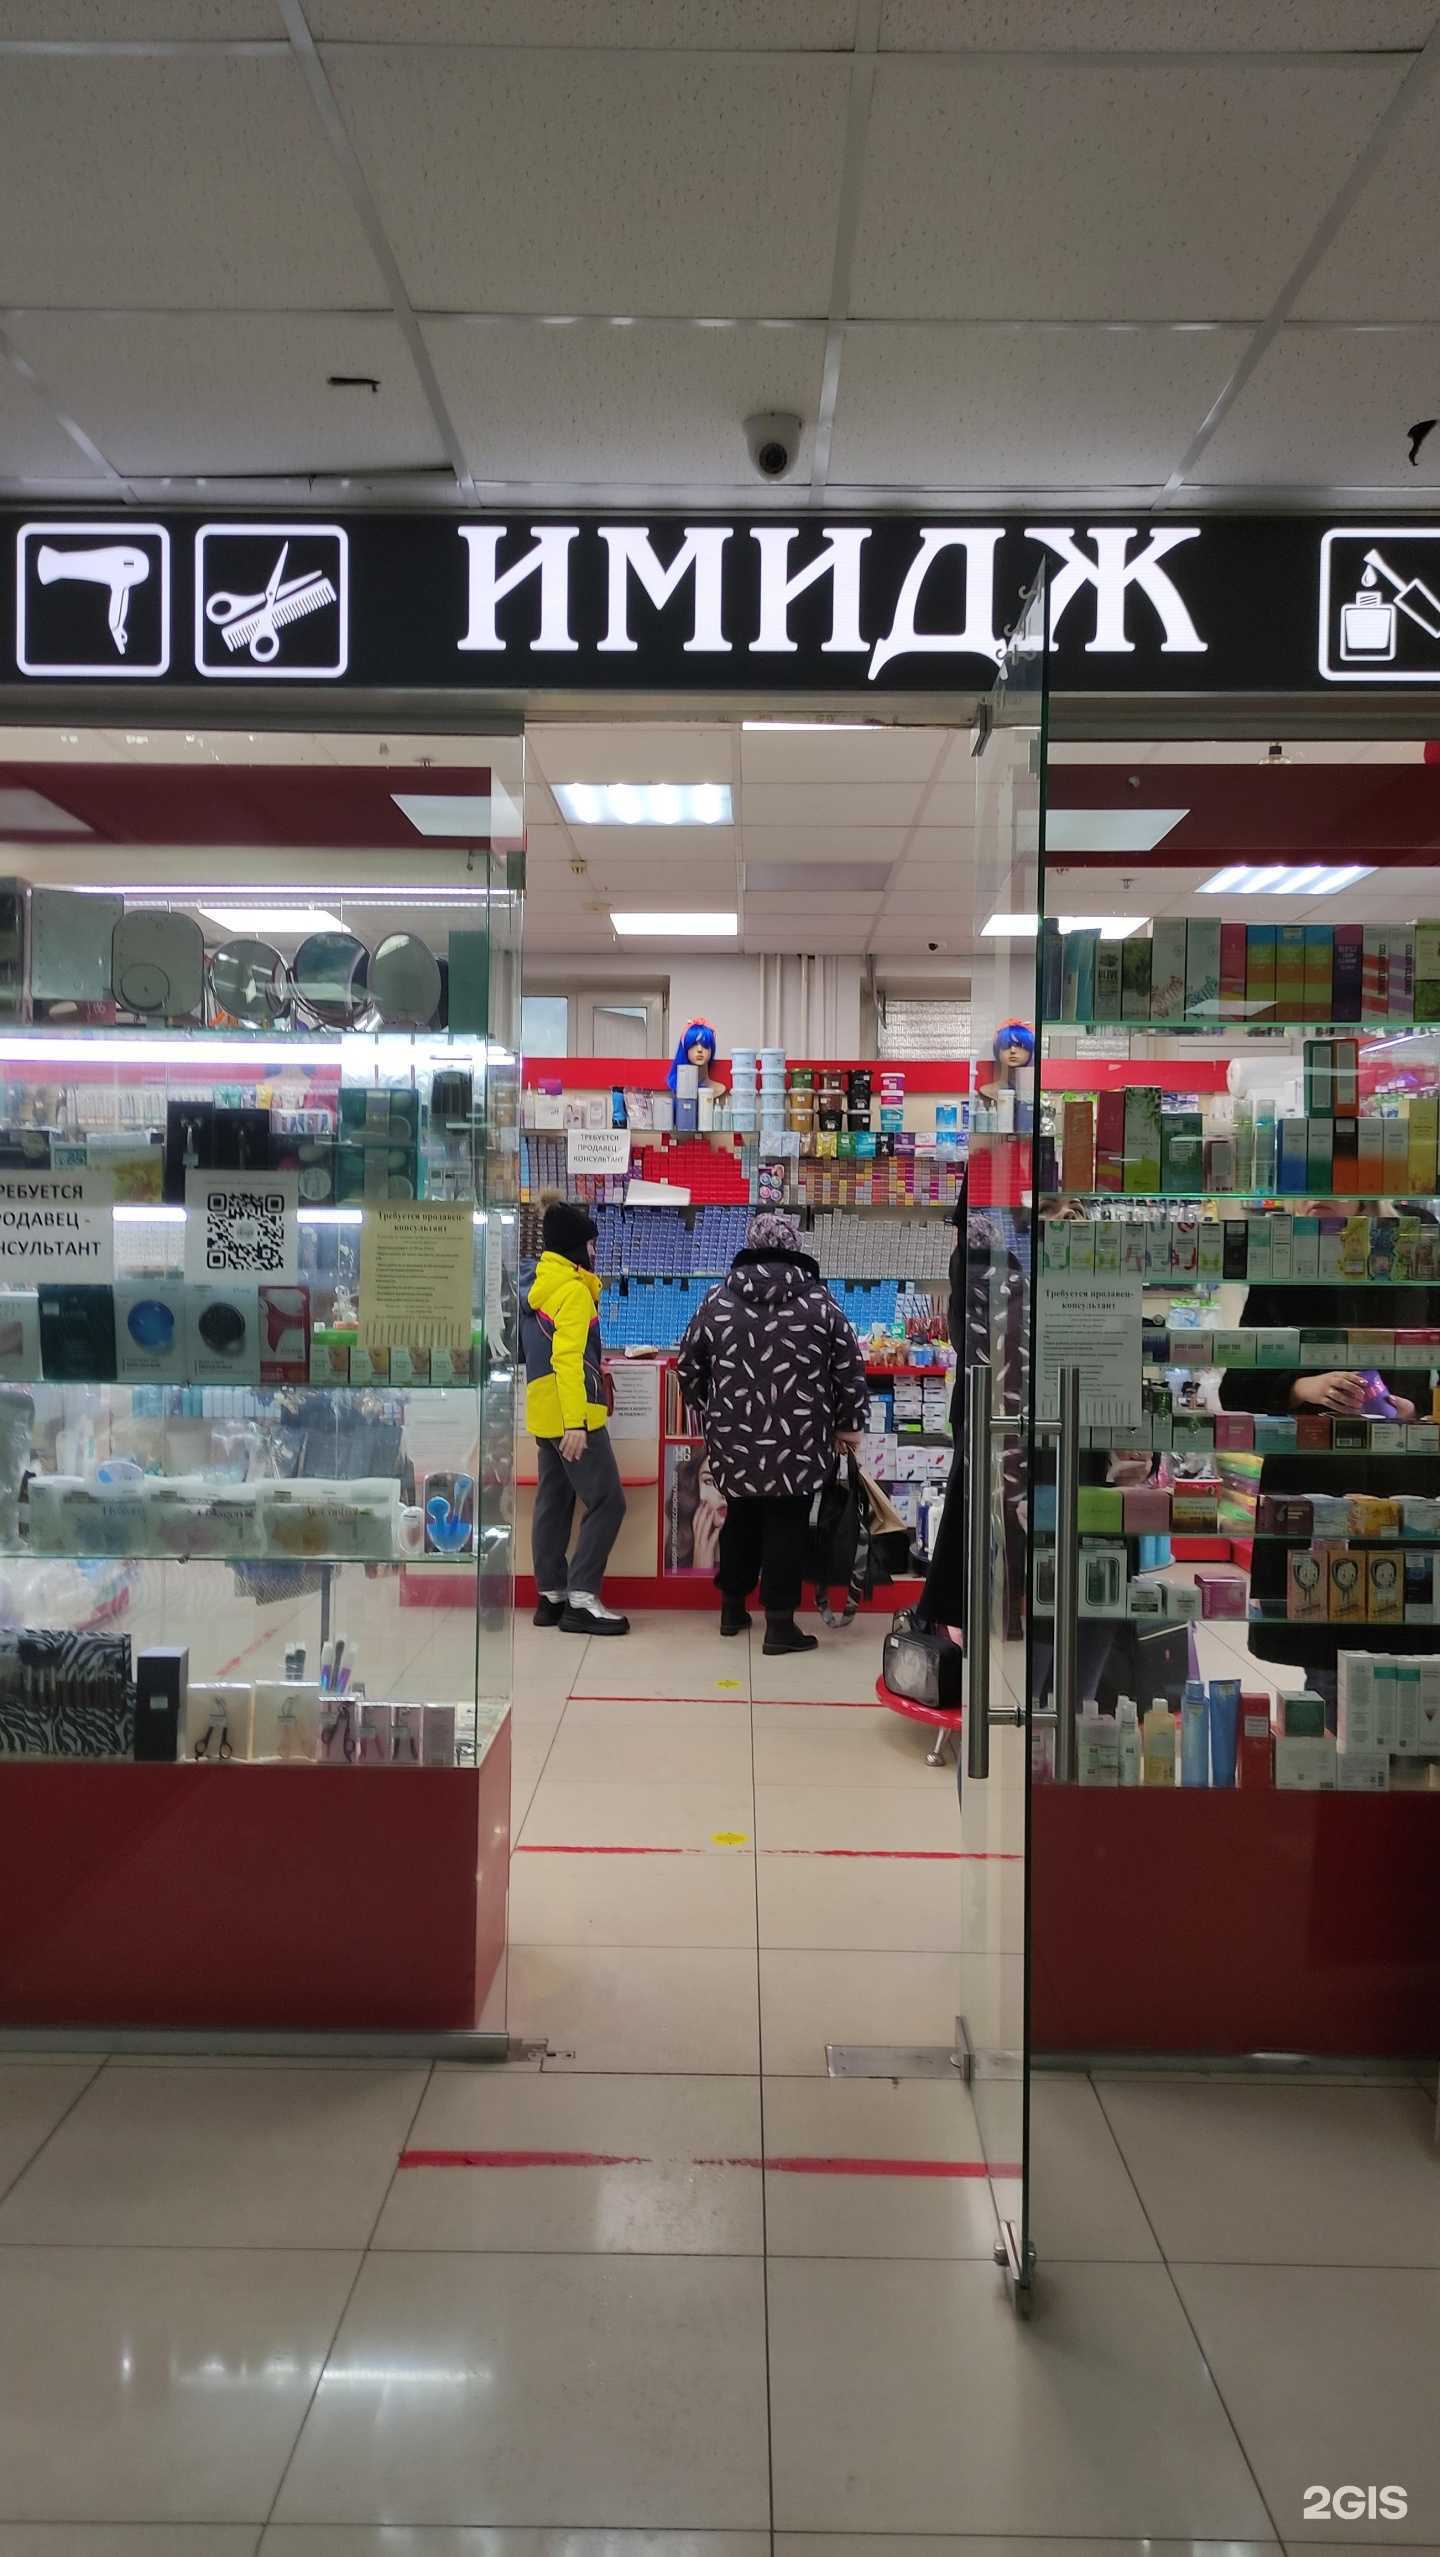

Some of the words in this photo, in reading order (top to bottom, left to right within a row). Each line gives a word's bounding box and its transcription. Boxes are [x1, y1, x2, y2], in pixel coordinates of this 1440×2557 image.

[456, 524, 1209, 680] ИМИДЖ
[0, 1212, 79, 1230] ОДАВЕЦ
[394, 1225, 447, 1233] консультант
[1046, 1289, 1088, 1299] Требуется
[1062, 1302, 1115, 1311] консультант
